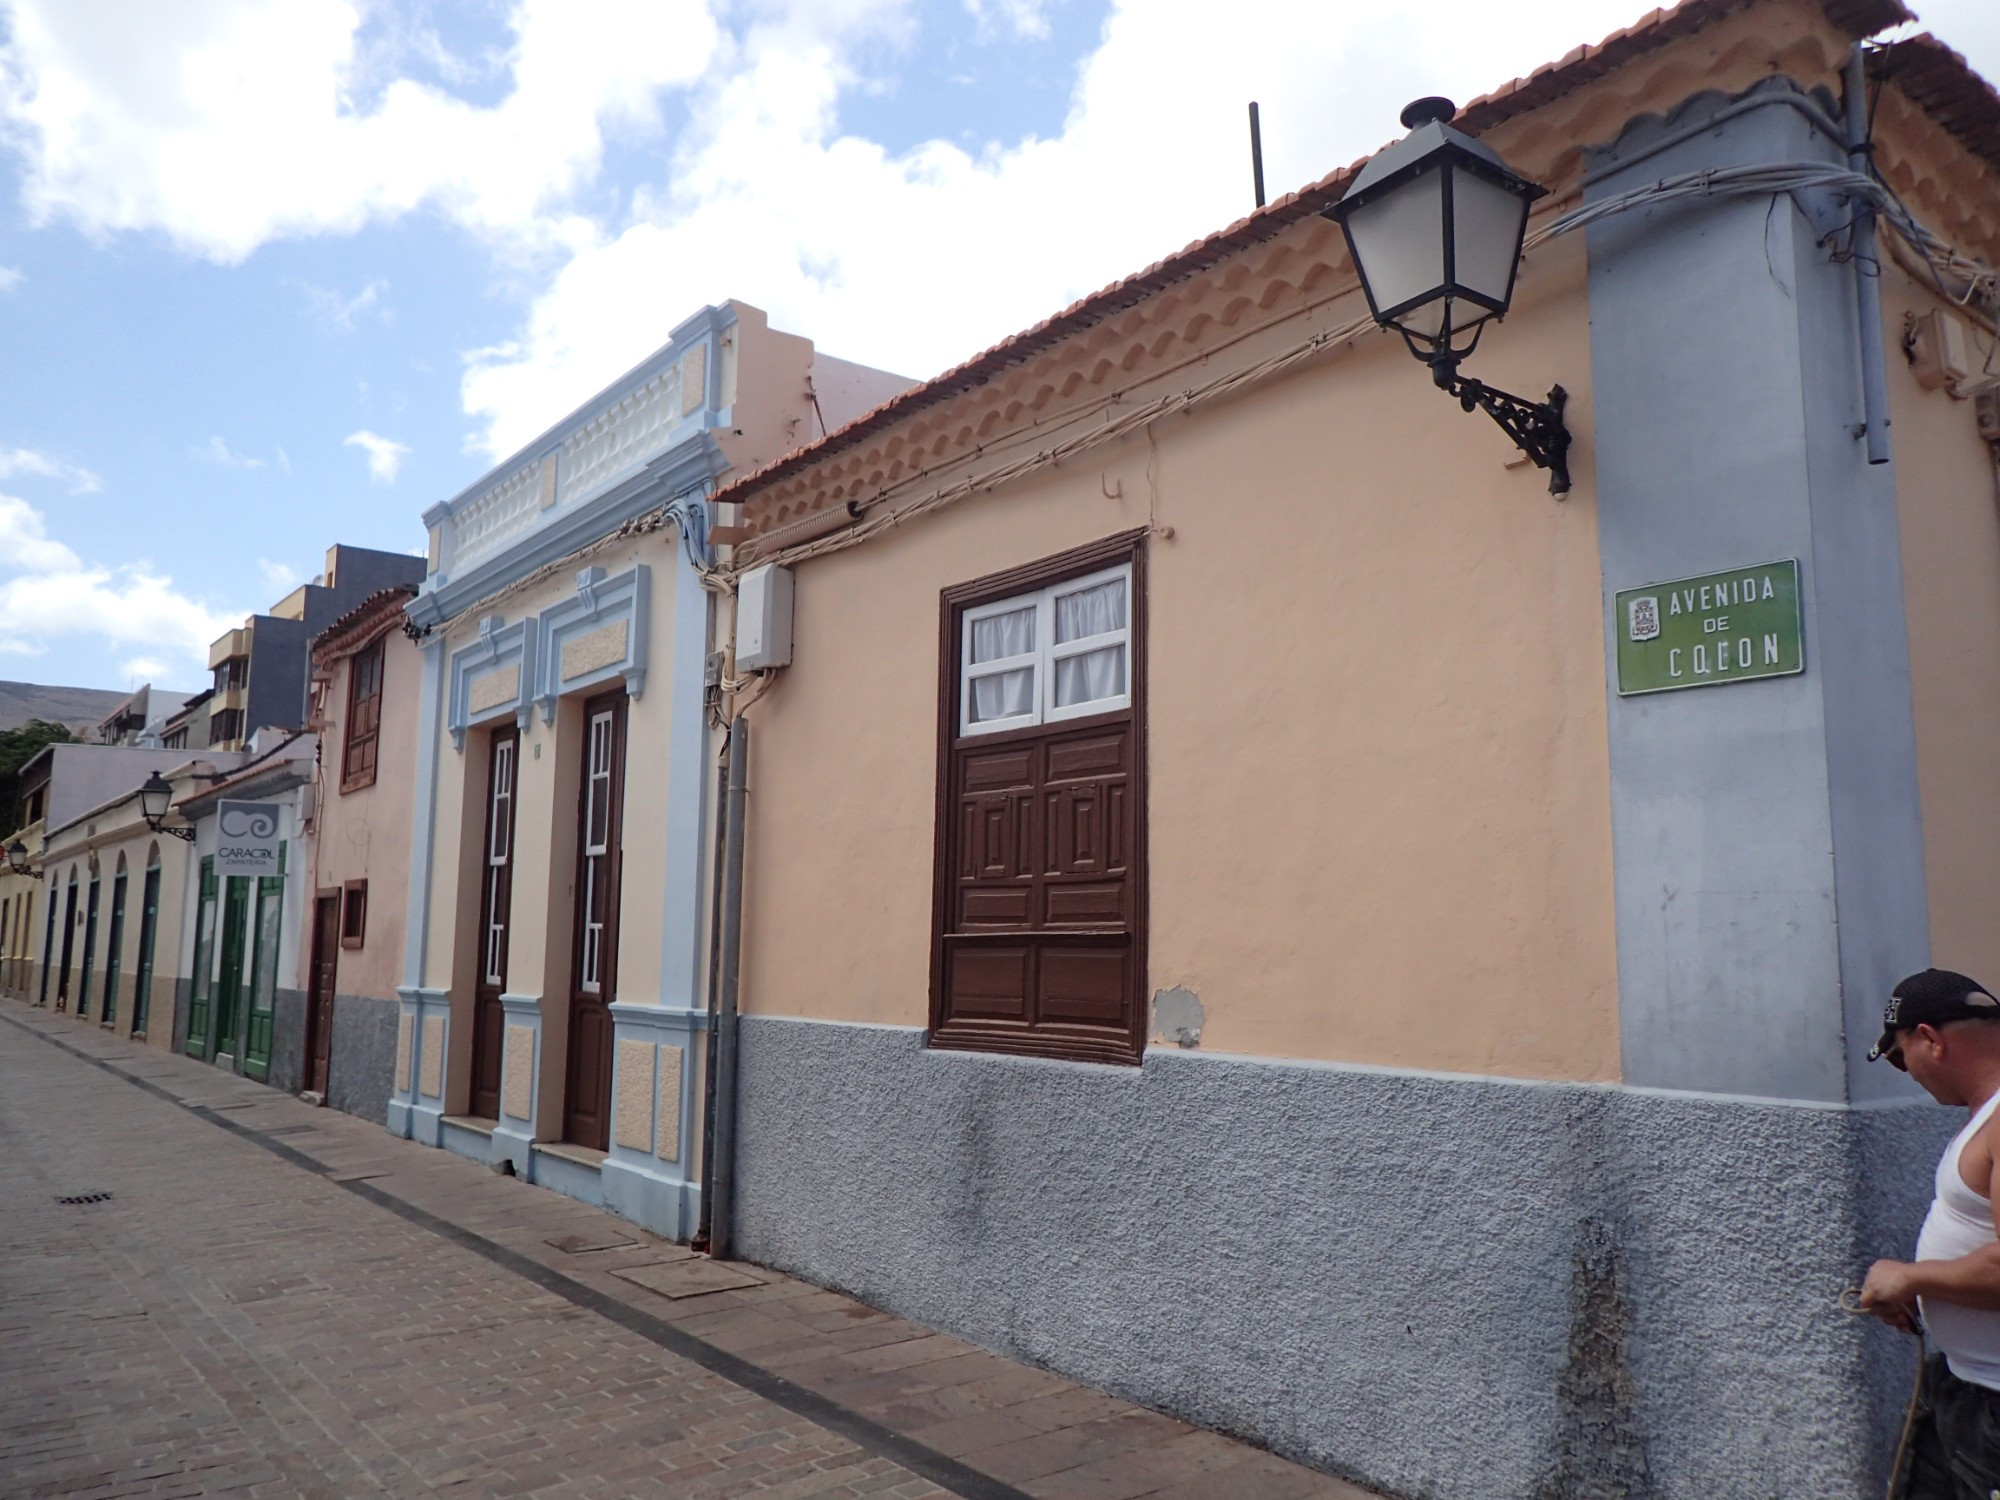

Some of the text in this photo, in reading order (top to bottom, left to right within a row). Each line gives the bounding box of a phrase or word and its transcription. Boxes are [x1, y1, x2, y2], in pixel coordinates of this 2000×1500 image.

[1670, 575, 1774, 615] AVENIDA
[1704, 616, 1730, 633] DE
[218, 847, 275, 859] CARACOL
